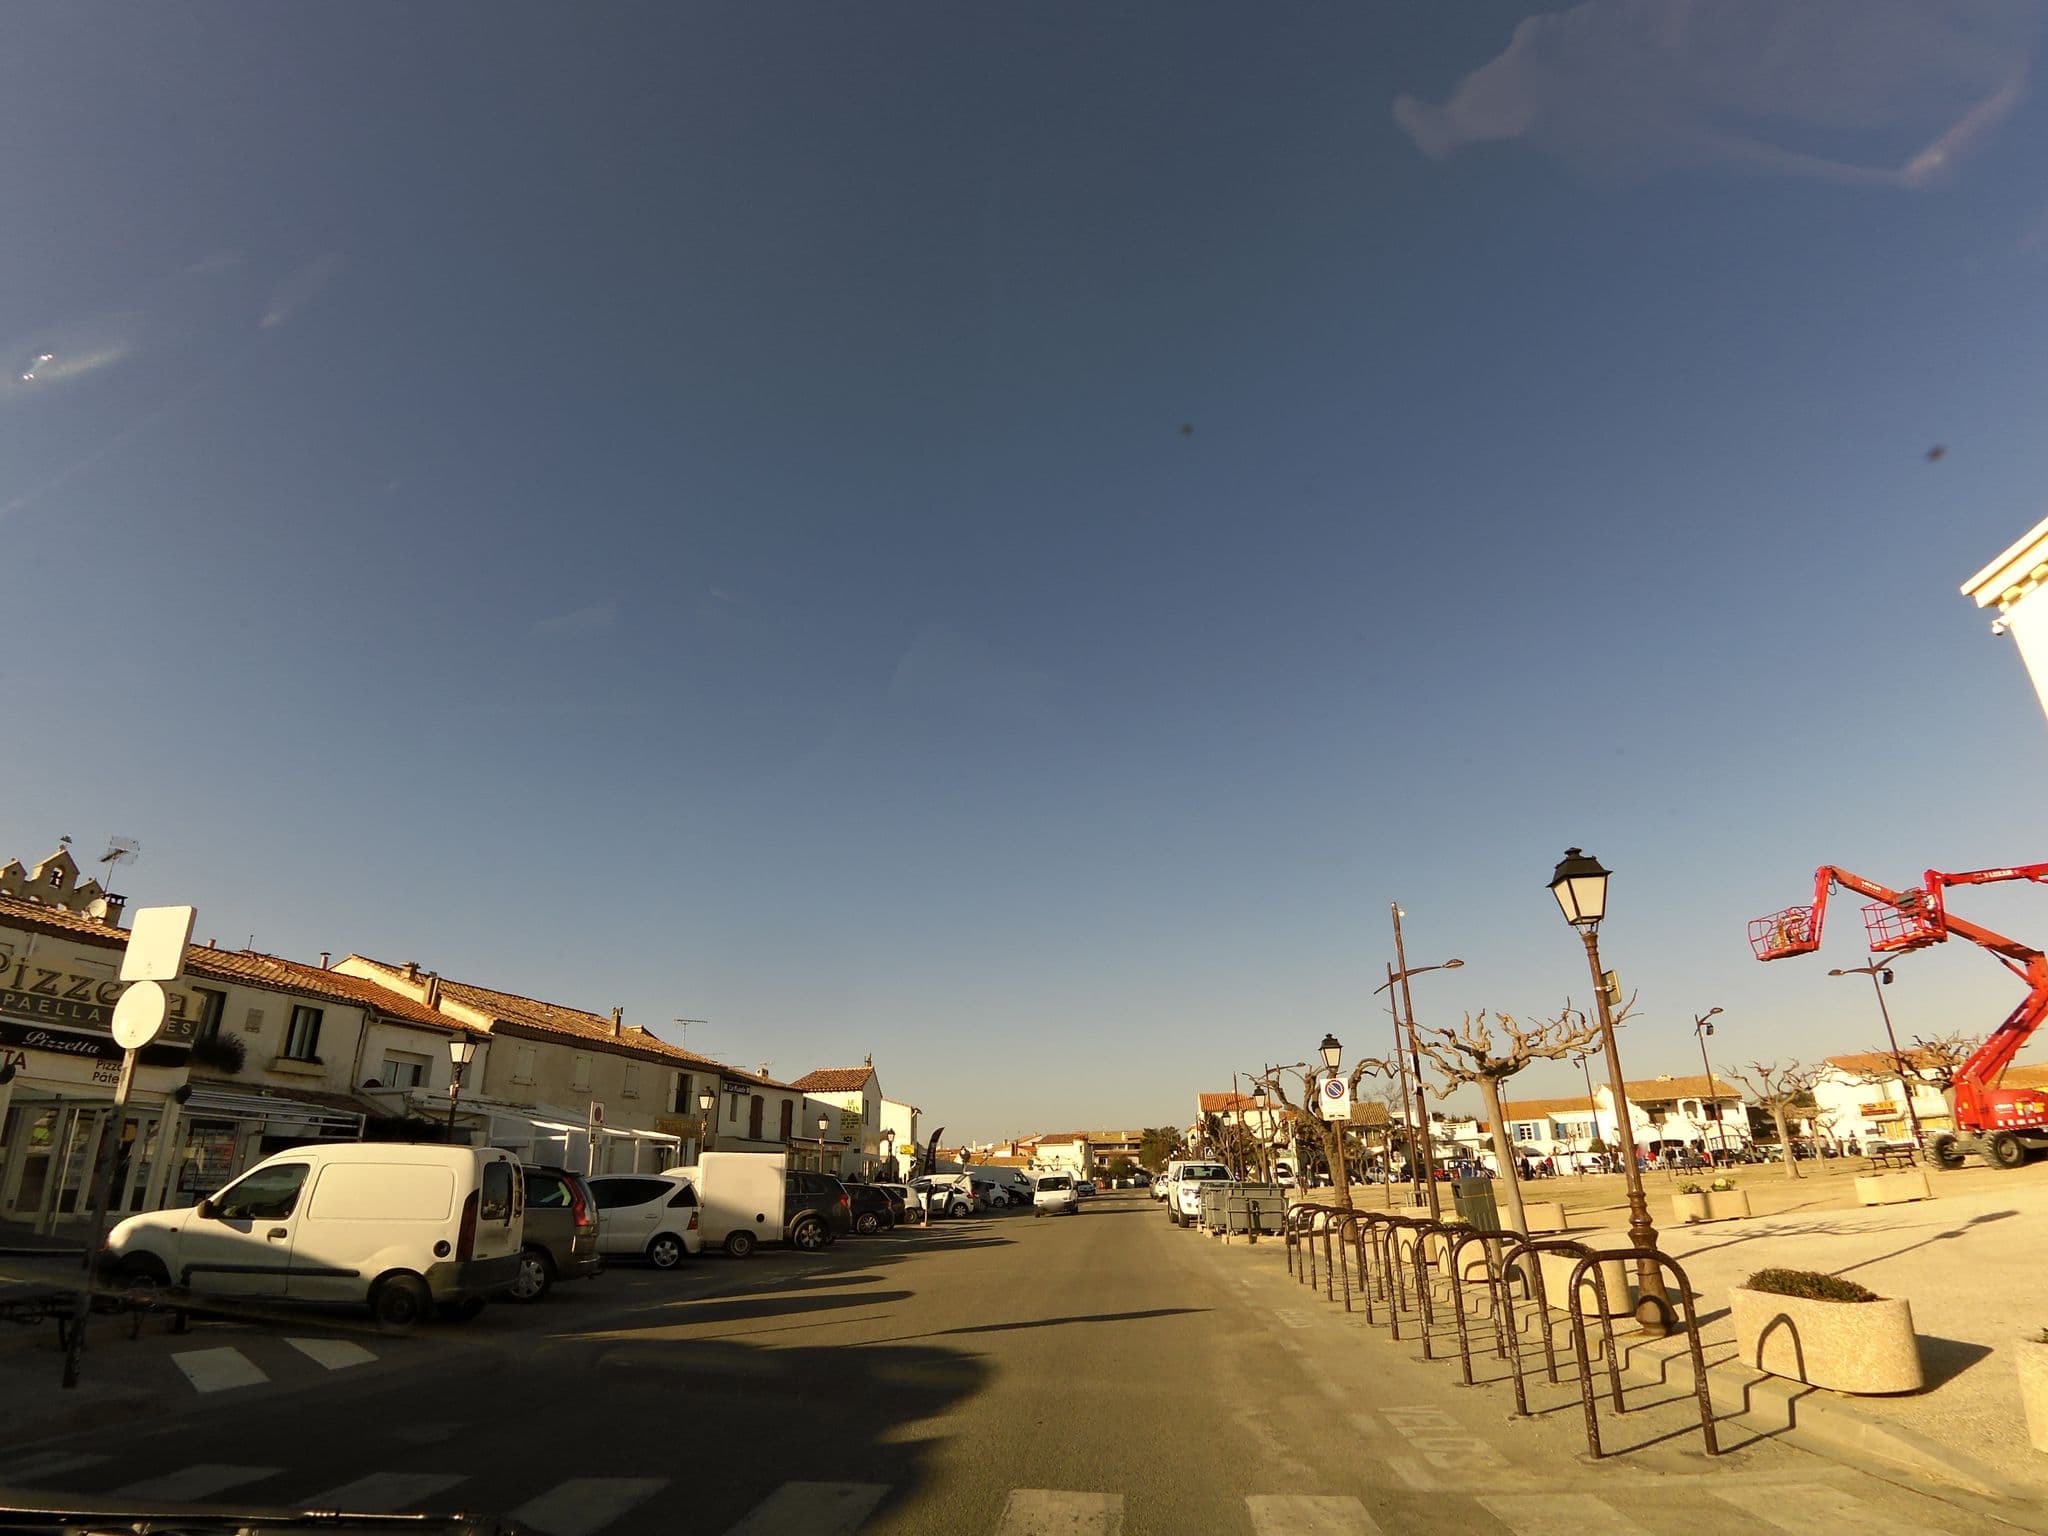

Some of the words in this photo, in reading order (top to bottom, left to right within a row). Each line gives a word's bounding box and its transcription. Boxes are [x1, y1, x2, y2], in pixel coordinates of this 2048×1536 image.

[3, 993, 101, 1022] PAELLA
[21, 1030, 101, 1055] Pizzetta
[92, 1072, 120, 1084] Pâte
